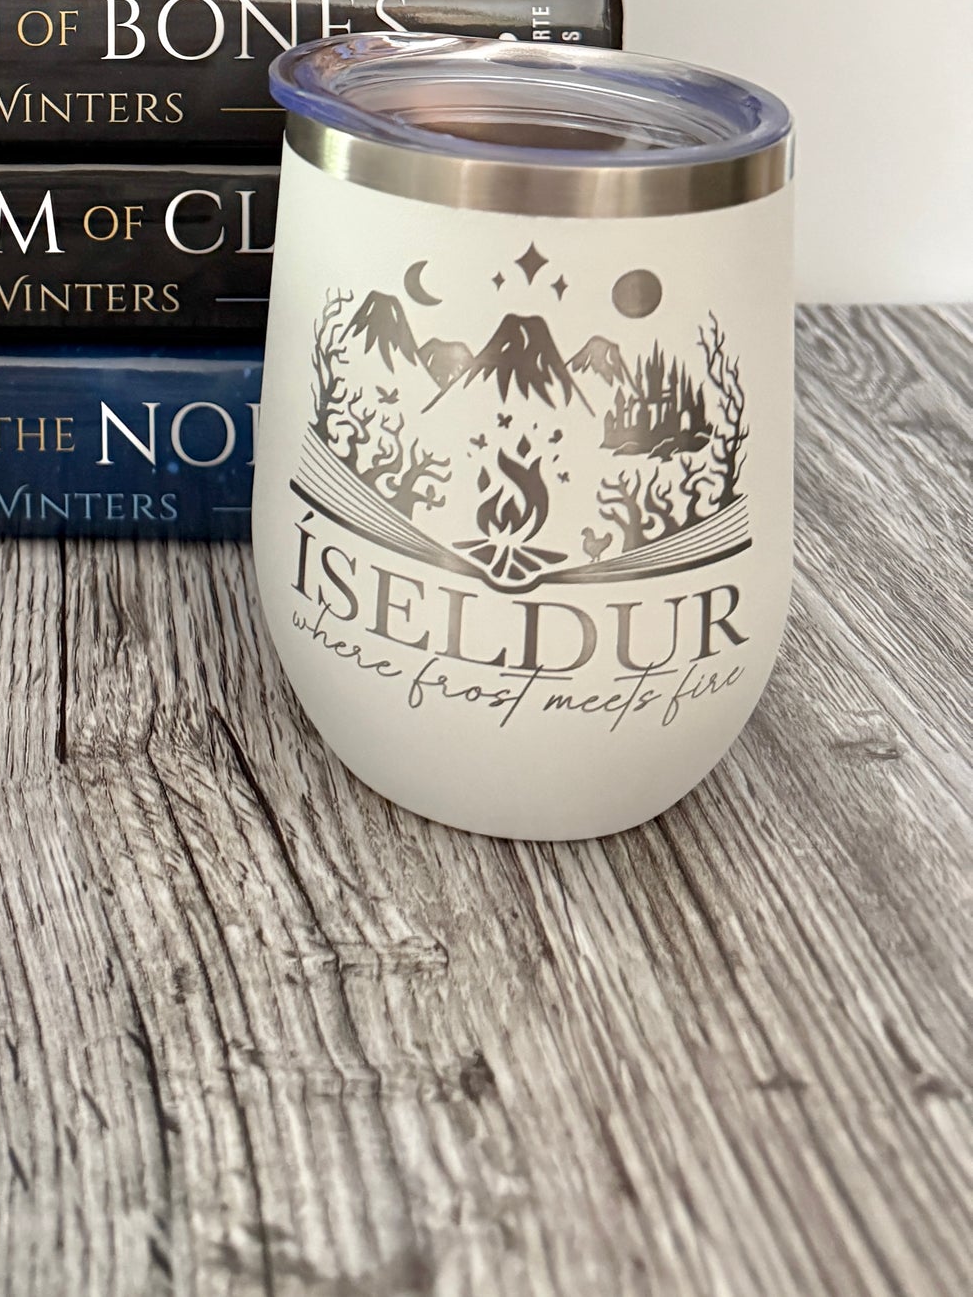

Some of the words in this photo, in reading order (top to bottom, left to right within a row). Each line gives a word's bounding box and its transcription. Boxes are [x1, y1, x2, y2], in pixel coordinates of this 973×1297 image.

[17, 10, 79, 47] OF
[83, 205, 144, 241] OF
[289, 510, 750, 673] ÍSELDUR
[292, 602, 402, 678] where
[408, 657, 574, 729] frost
[542, 661, 679, 733] meets
[661, 663, 746, 727] fire
